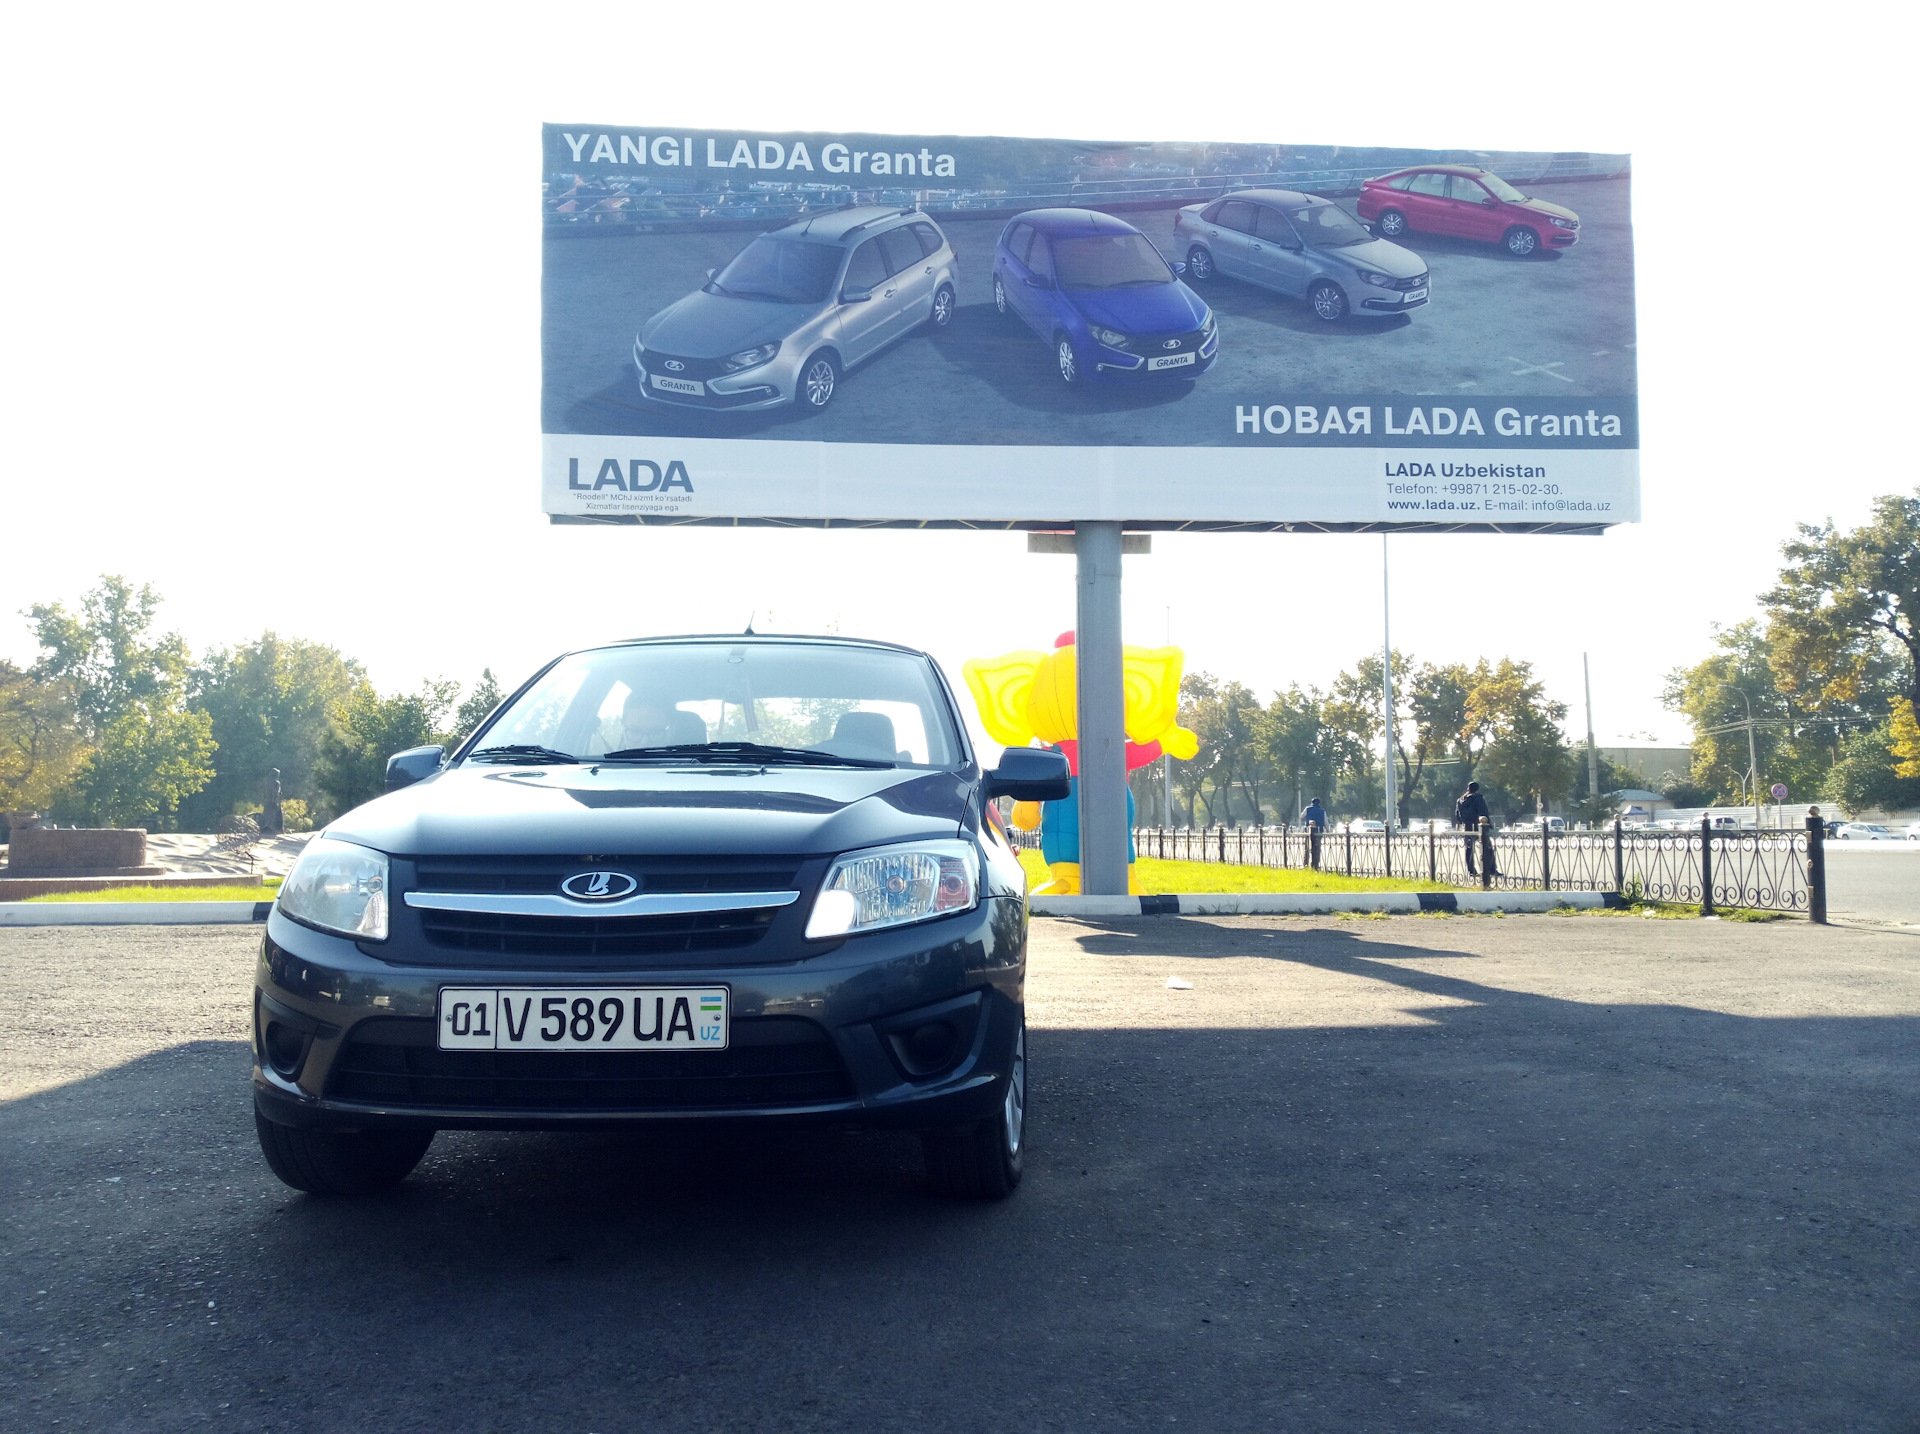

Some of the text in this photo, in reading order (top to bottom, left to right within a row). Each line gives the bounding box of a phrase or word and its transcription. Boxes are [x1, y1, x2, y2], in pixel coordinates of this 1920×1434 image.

[563, 133, 956, 177] YANGI LADA Granta
[1156, 356, 1188, 367] GRANTA
[660, 379, 696, 392] GRANTA
[1235, 405, 1622, 437] НОВАЯ LADA Granta
[569, 457, 694, 493] LADA
[1385, 462, 1546, 478] LADA Uzbekistan
[1386, 483, 1563, 495] Telefon: +99871 215-02-30.
[610, 493, 632, 501] MChJ
[586, 502, 621, 510] Xizmatlar
[1387, 499, 1611, 512] www.lada.uz. E-mail: info@lada.uz
[451, 1003, 491, 1036] 01
[700, 1026, 721, 1040] UZ
